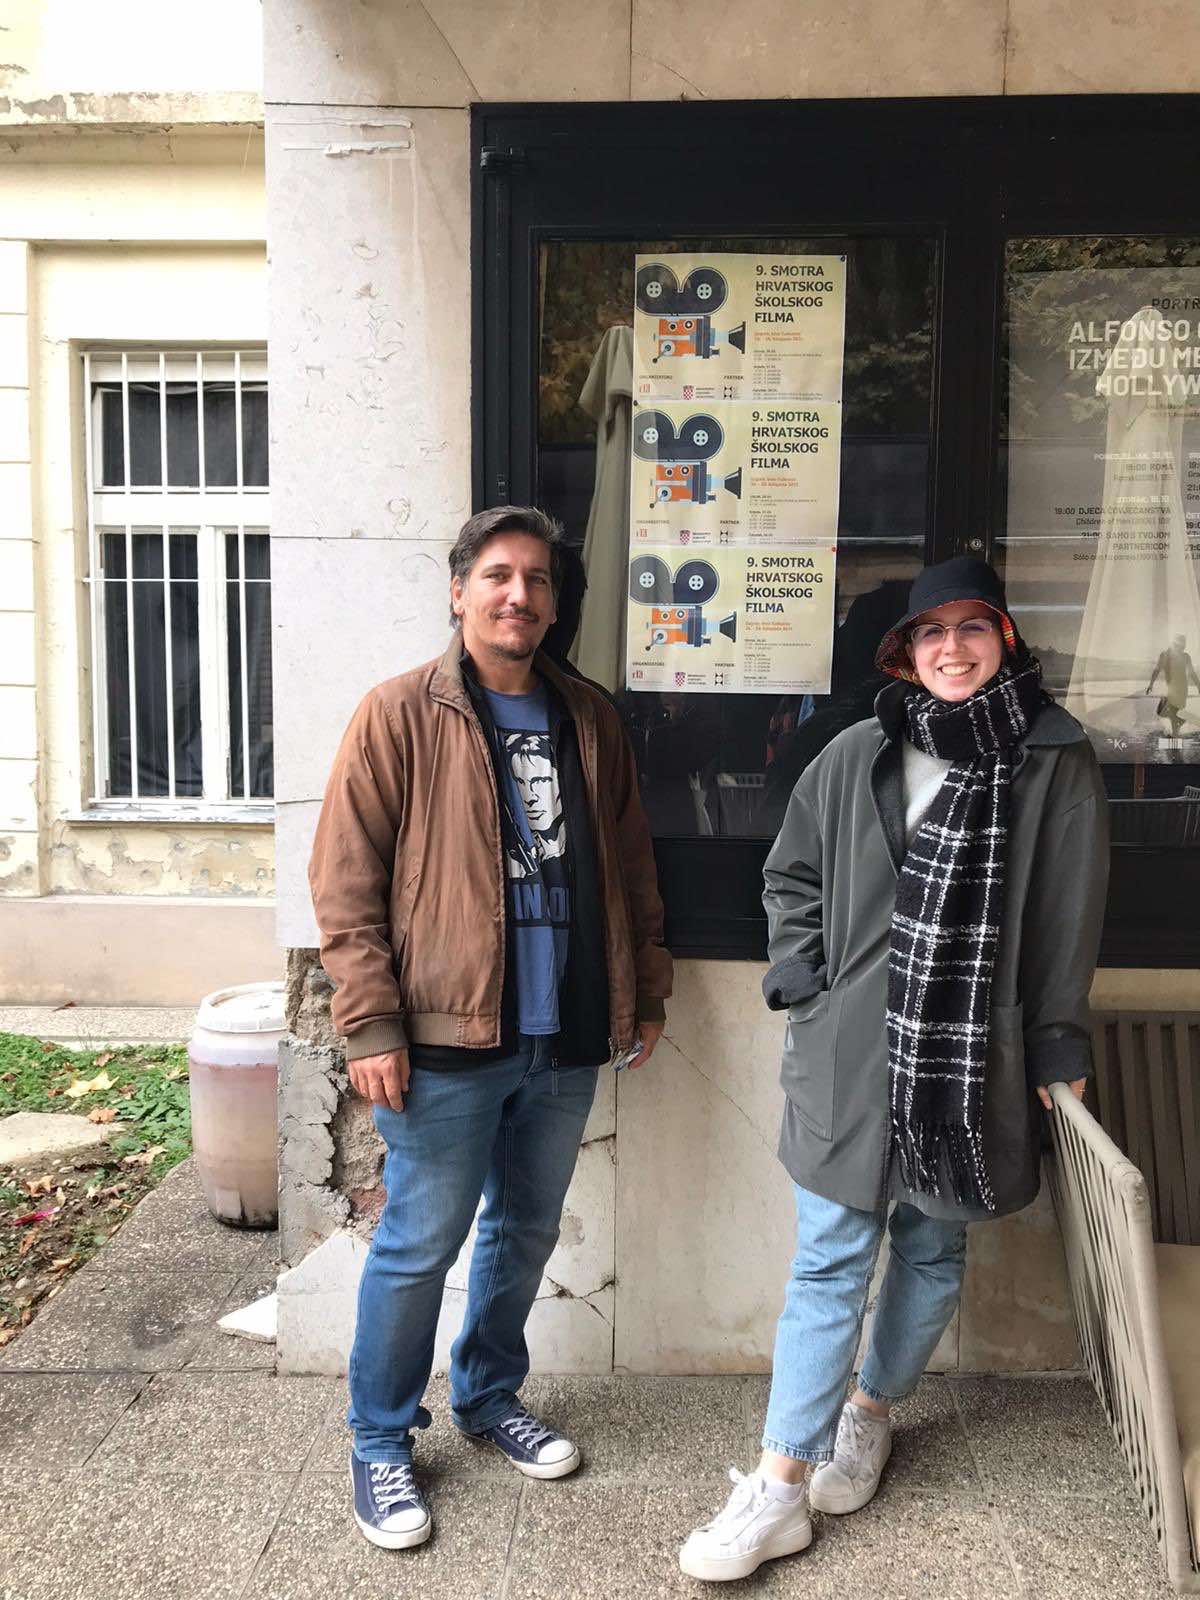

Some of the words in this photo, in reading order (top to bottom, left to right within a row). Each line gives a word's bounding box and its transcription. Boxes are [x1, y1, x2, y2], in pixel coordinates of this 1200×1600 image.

[756, 265, 767, 276] 9.
[771, 265, 825, 277] SMOTRA
[755, 281, 833, 292] HRVATSKOG
[754, 293, 824, 308] ŠKOLSKOG
[754, 312, 794, 323] FILMA
[1068, 319, 1191, 343] ALFONSO
[752, 411, 763, 422] 9.
[766, 411, 820, 422] SMOTRA
[751, 426, 829, 438] HRVATSKOG
[750, 439, 819, 453] ŠKOLSKOG
[750, 458, 790, 469] FILMA
[747, 557, 758, 568] 9.
[761, 557, 815, 568] SMOTRA
[746, 572, 824, 583] HRVATSKOG
[745, 585, 813, 598] ŠKOLSKOG
[745, 602, 785, 613] FILMA
